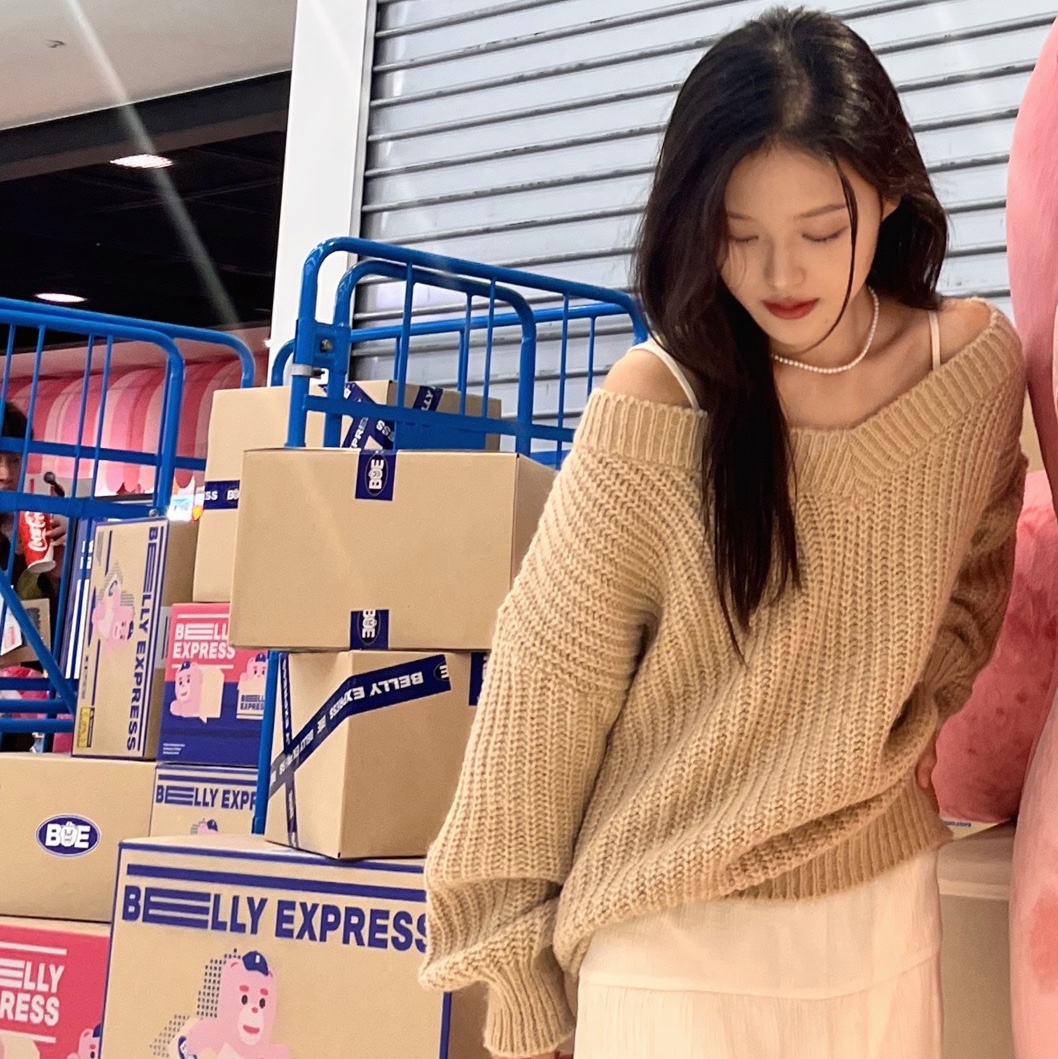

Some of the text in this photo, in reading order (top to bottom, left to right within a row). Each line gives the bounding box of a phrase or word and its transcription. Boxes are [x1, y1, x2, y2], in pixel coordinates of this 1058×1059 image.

[175, 623, 228, 641] BELL
[173, 641, 236, 659] EXPRESS
[127, 641, 146, 752] EXPRESS
[370, 671, 424, 697] BELLY
[156, 785, 256, 811] BELLY EXPR
[122, 885, 268, 935] BELLY
[0, 990, 60, 1026] RESS
